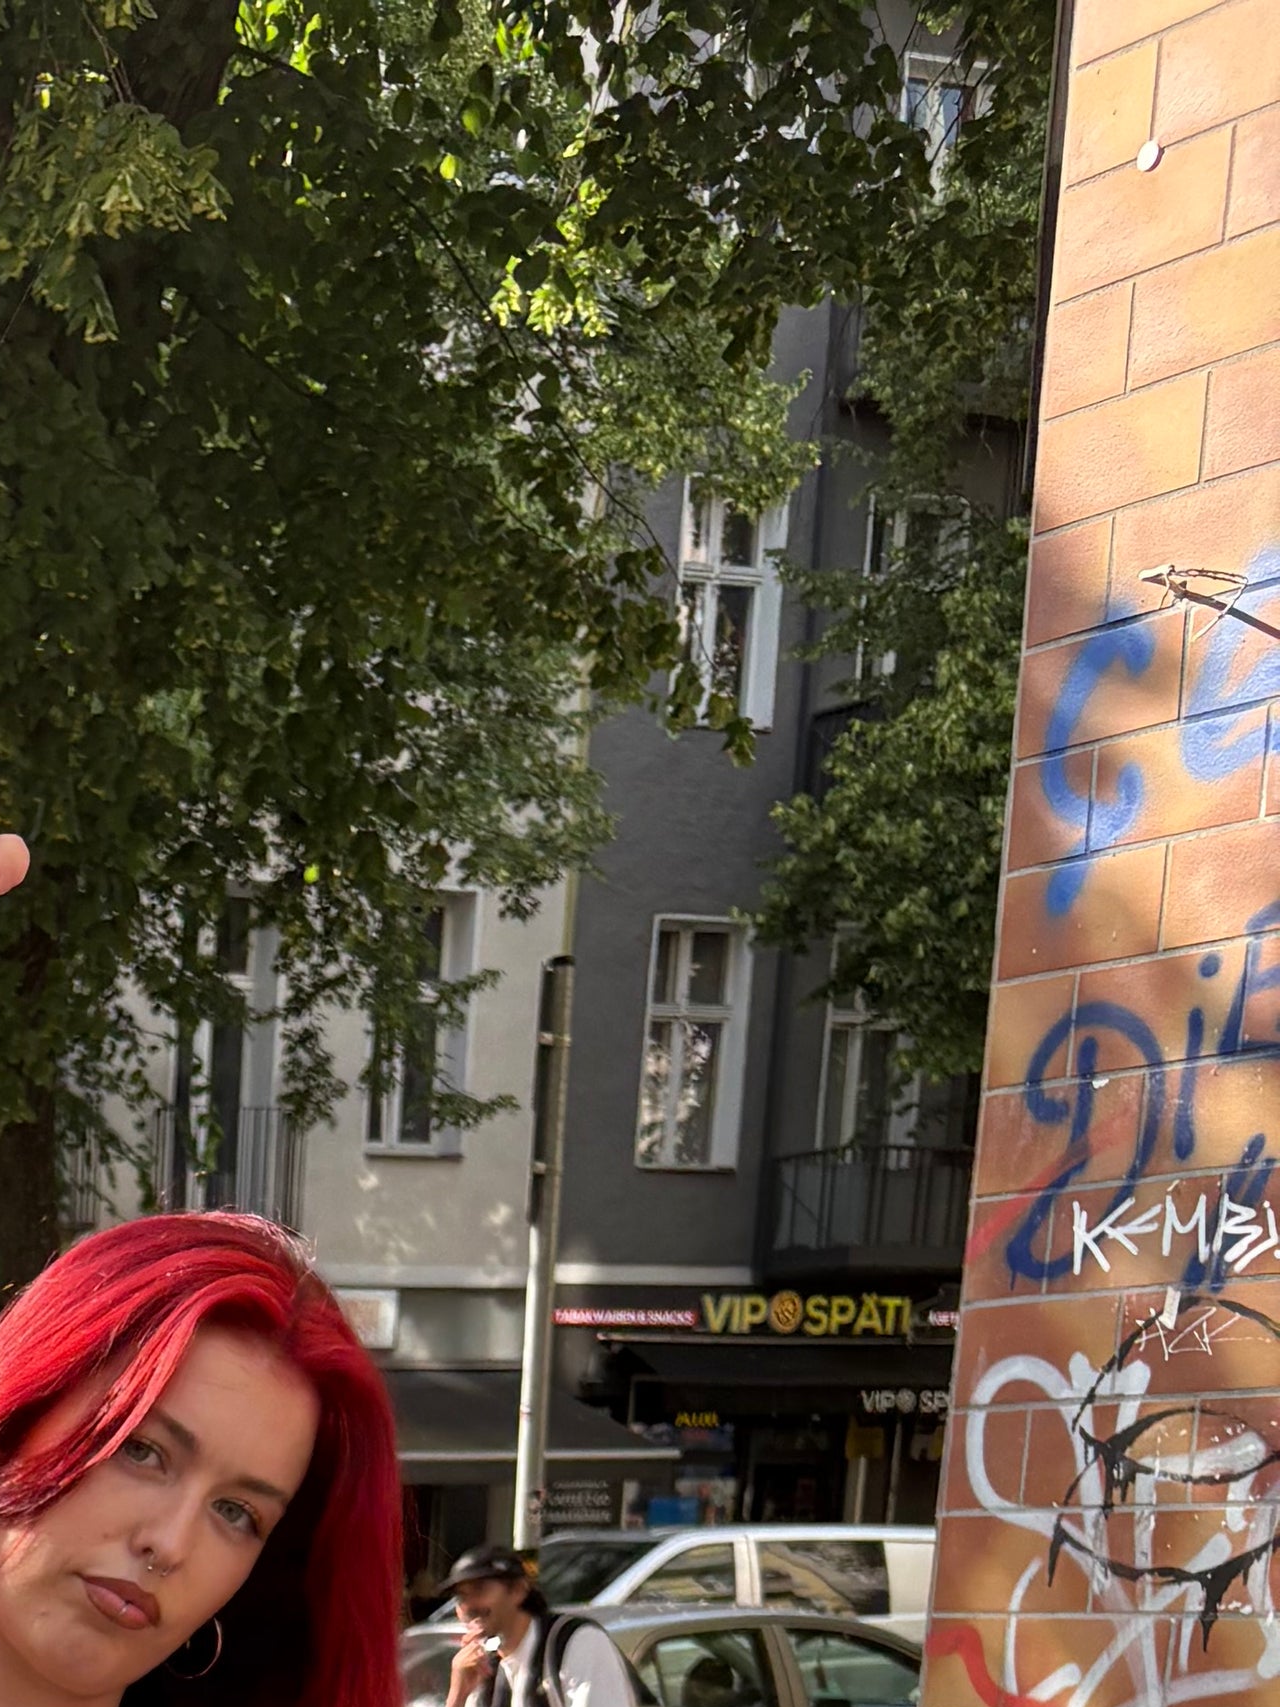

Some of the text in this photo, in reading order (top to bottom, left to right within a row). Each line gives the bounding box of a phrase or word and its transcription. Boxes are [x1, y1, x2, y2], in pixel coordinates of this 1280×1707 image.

[702, 1292, 912, 1336] VIP SPÄTI
[861, 1389, 895, 1413] VIP
